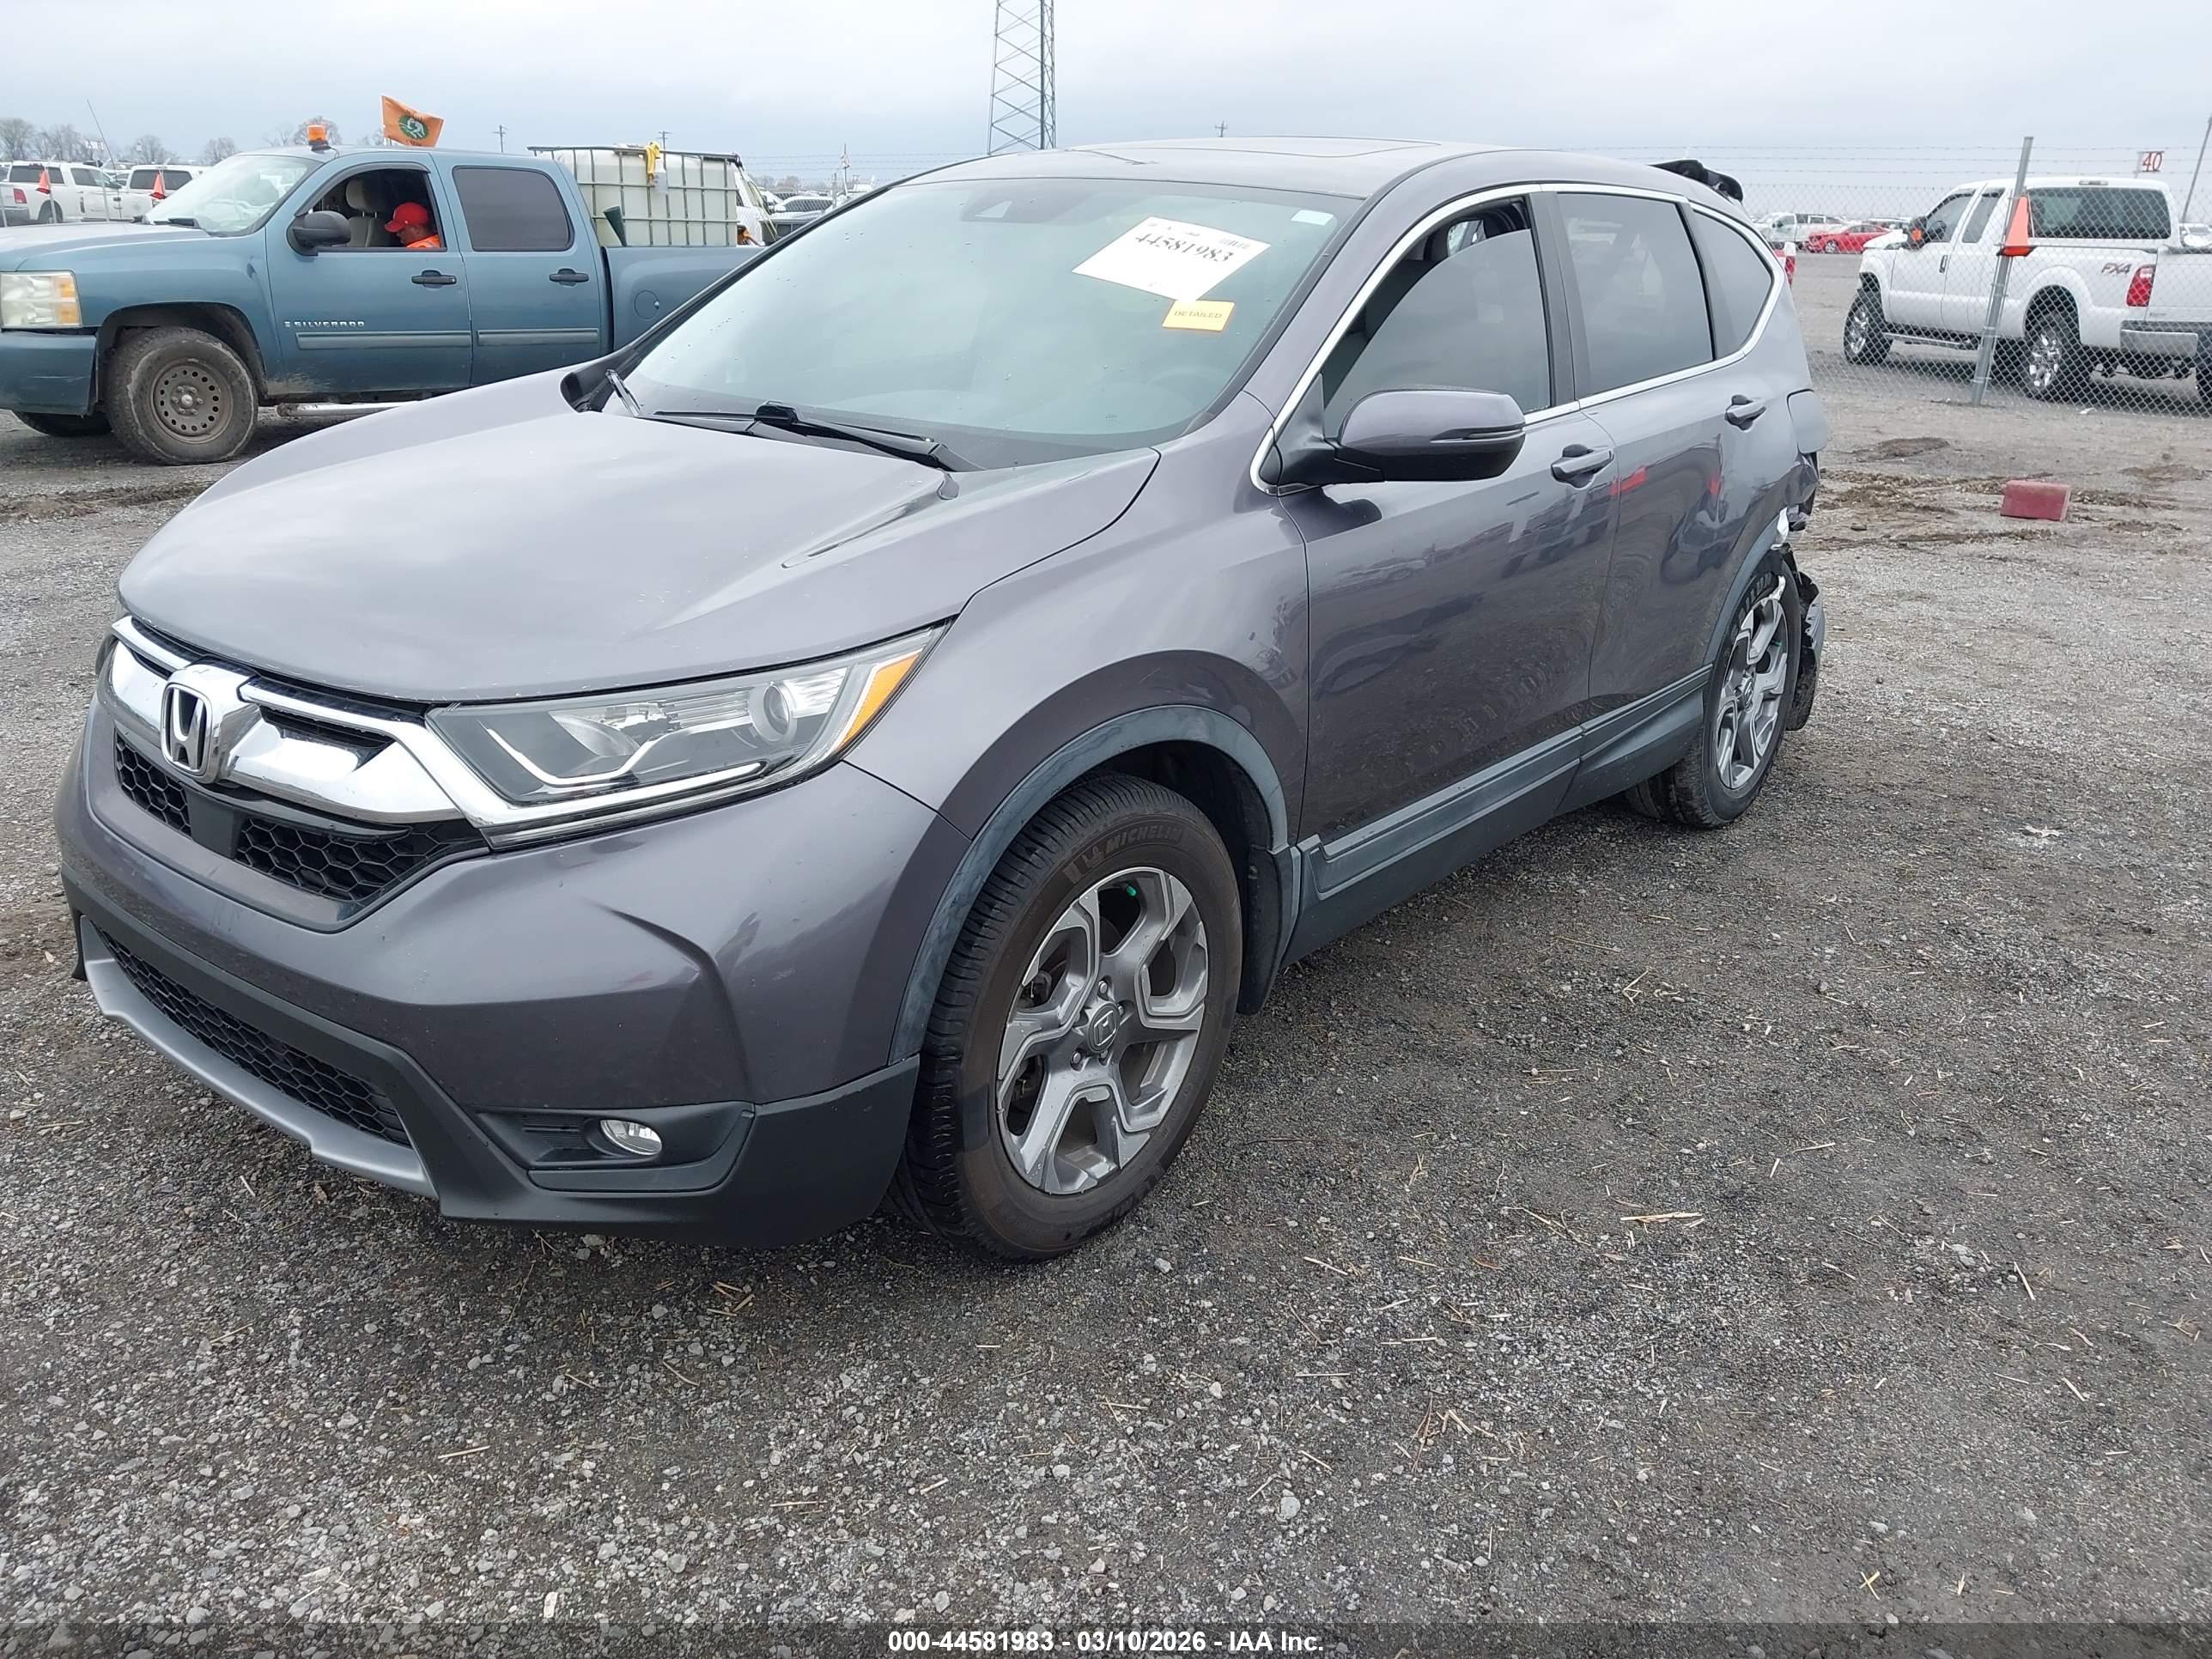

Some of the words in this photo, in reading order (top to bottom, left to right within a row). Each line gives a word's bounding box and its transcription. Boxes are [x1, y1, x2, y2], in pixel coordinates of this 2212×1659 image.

[2142, 151, 2163, 172] 40
[1135, 233, 1234, 262] 44581983
[2101, 262, 2133, 275] FX4
[1174, 310, 1223, 319] DETAILED
[1105, 824, 1184, 854] MICHELIN
